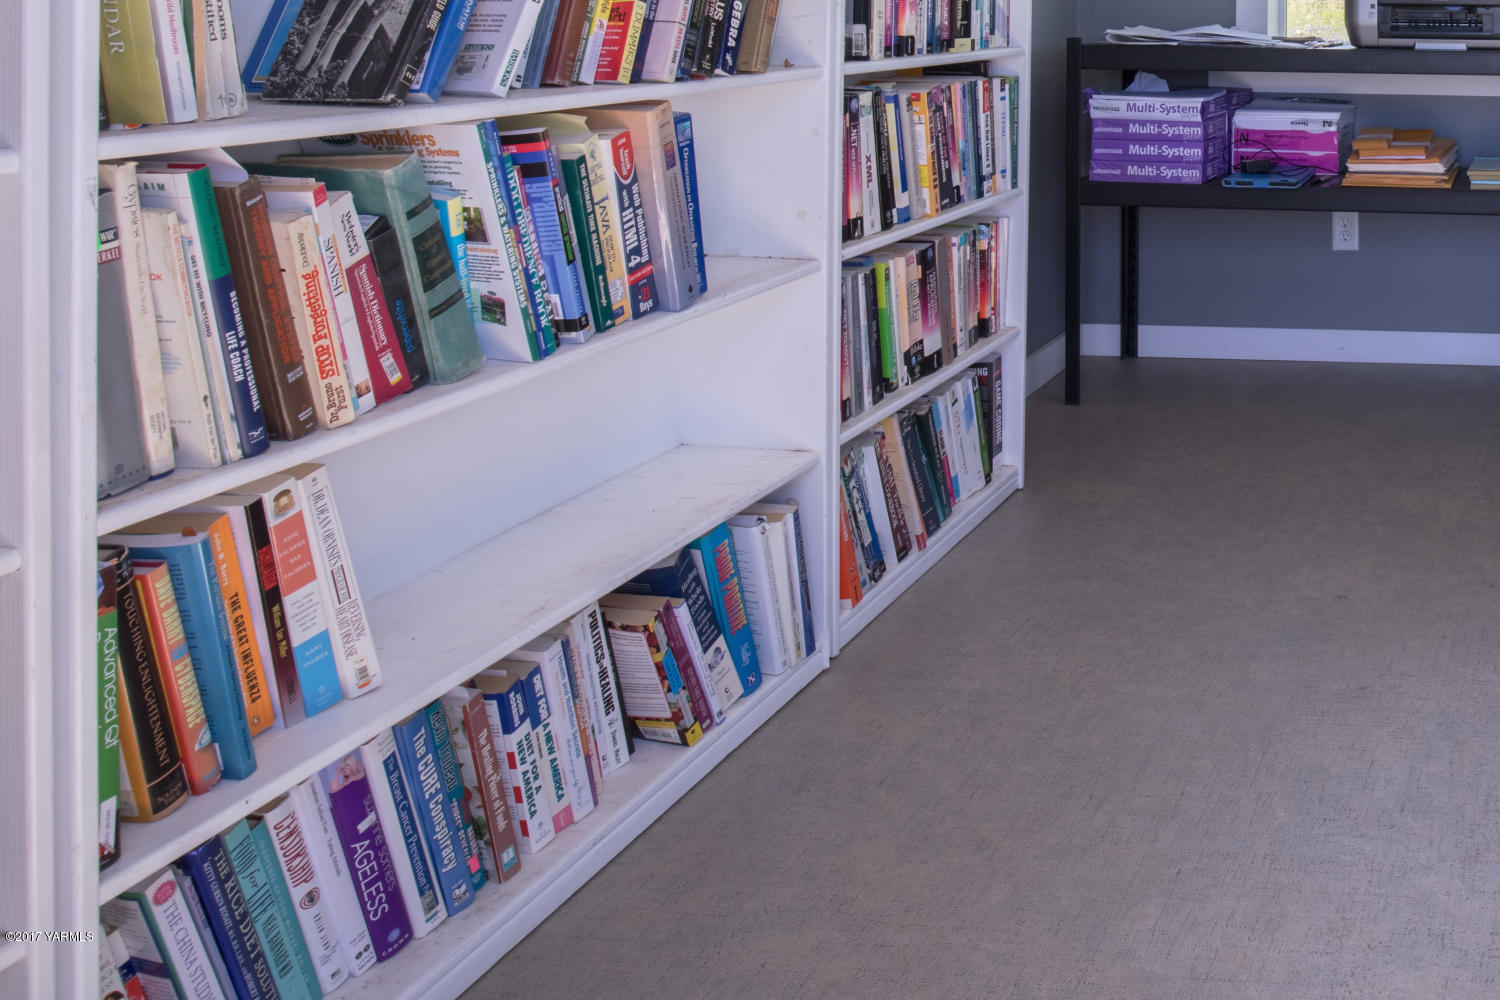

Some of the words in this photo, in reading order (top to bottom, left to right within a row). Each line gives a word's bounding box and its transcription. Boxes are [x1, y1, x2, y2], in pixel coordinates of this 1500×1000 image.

[168, 14, 180, 55] Mushroom
[428, 10, 442, 31] GUIDE
[1126, 102, 1200, 115] Multi-System
[358, 131, 437, 149] Sprinklers
[1128, 123, 1201, 137] Multi-System
[425, 147, 460, 158] Systems
[1128, 144, 1201, 158] Multi-System
[865, 154, 874, 189] XML
[1127, 165, 1200, 179] Multi-System
[582, 178, 593, 213] ULTIMATE
[622, 189, 630, 207] with
[632, 183, 641, 207] Web
[487, 161, 505, 216] SPRINKLERS
[502, 224, 517, 270] WATERING
[512, 267, 528, 308] SYSTEMS
[588, 213, 596, 232] TIME
[622, 208, 639, 254] HTML
[636, 207, 650, 263] Publishing
[322, 236, 344, 298] SPANISH
[507, 171, 521, 206] DOG
[515, 209, 541, 285] OBEDIENCE
[534, 288, 550, 328] BOOK
[591, 232, 602, 266] MACHINE
[628, 255, 641, 267] 4
[359, 263, 376, 300] Spanish
[369, 299, 388, 346] Dictionary
[225, 331, 239, 350] LIFE
[229, 290, 245, 338] BECOMING
[242, 348, 261, 413] PROFESSIONAL
[229, 351, 245, 383] COACH
[314, 343, 336, 381] STOP
[325, 382, 337, 410] Bruno
[335, 385, 348, 413] Furst
[155, 575, 176, 608] DAVE
[229, 592, 241, 612] THE
[162, 605, 186, 646] BARRY
[233, 613, 249, 647] GREAT
[104, 627, 119, 723] Advanced
[123, 591, 146, 662] TOUCHING
[138, 661, 170, 768] ENLIGHTENMENT
[240, 648, 262, 704] INFLUENZA
[588, 609, 606, 665] POLITICS
[598, 666, 616, 717] HEALING
[175, 656, 207, 729] CYBERSPACE
[532, 673, 544, 699] DIET
[537, 698, 549, 722] FOR
[542, 722, 551, 732] A
[413, 726, 427, 758] The
[430, 708, 446, 746] Kevin
[438, 741, 459, 793] Trudeau
[516, 738, 527, 767] NEW
[544, 732, 556, 756] NEW
[418, 753, 439, 800] CURE
[524, 732, 535, 758] DIET
[530, 759, 540, 783] FOR
[535, 784, 543, 795] A
[549, 758, 565, 803] AMERICA
[521, 771, 538, 819] AMERICA
[390, 770, 403, 803] Breast
[399, 803, 412, 837] Cancer
[406, 836, 427, 889] Prevention
[429, 794, 458, 873] Conspiracy
[231, 834, 260, 880] FOOD
[273, 811, 316, 888] CENSORSHIP
[245, 868, 261, 889] for
[350, 839, 389, 922] AGELESS
[213, 847, 229, 880] THE
[224, 878, 245, 920] RICE
[239, 918, 262, 960] DIET
[248, 881, 276, 923] LIFE
[163, 898, 184, 932] THE
[175, 924, 197, 969] CHINA
